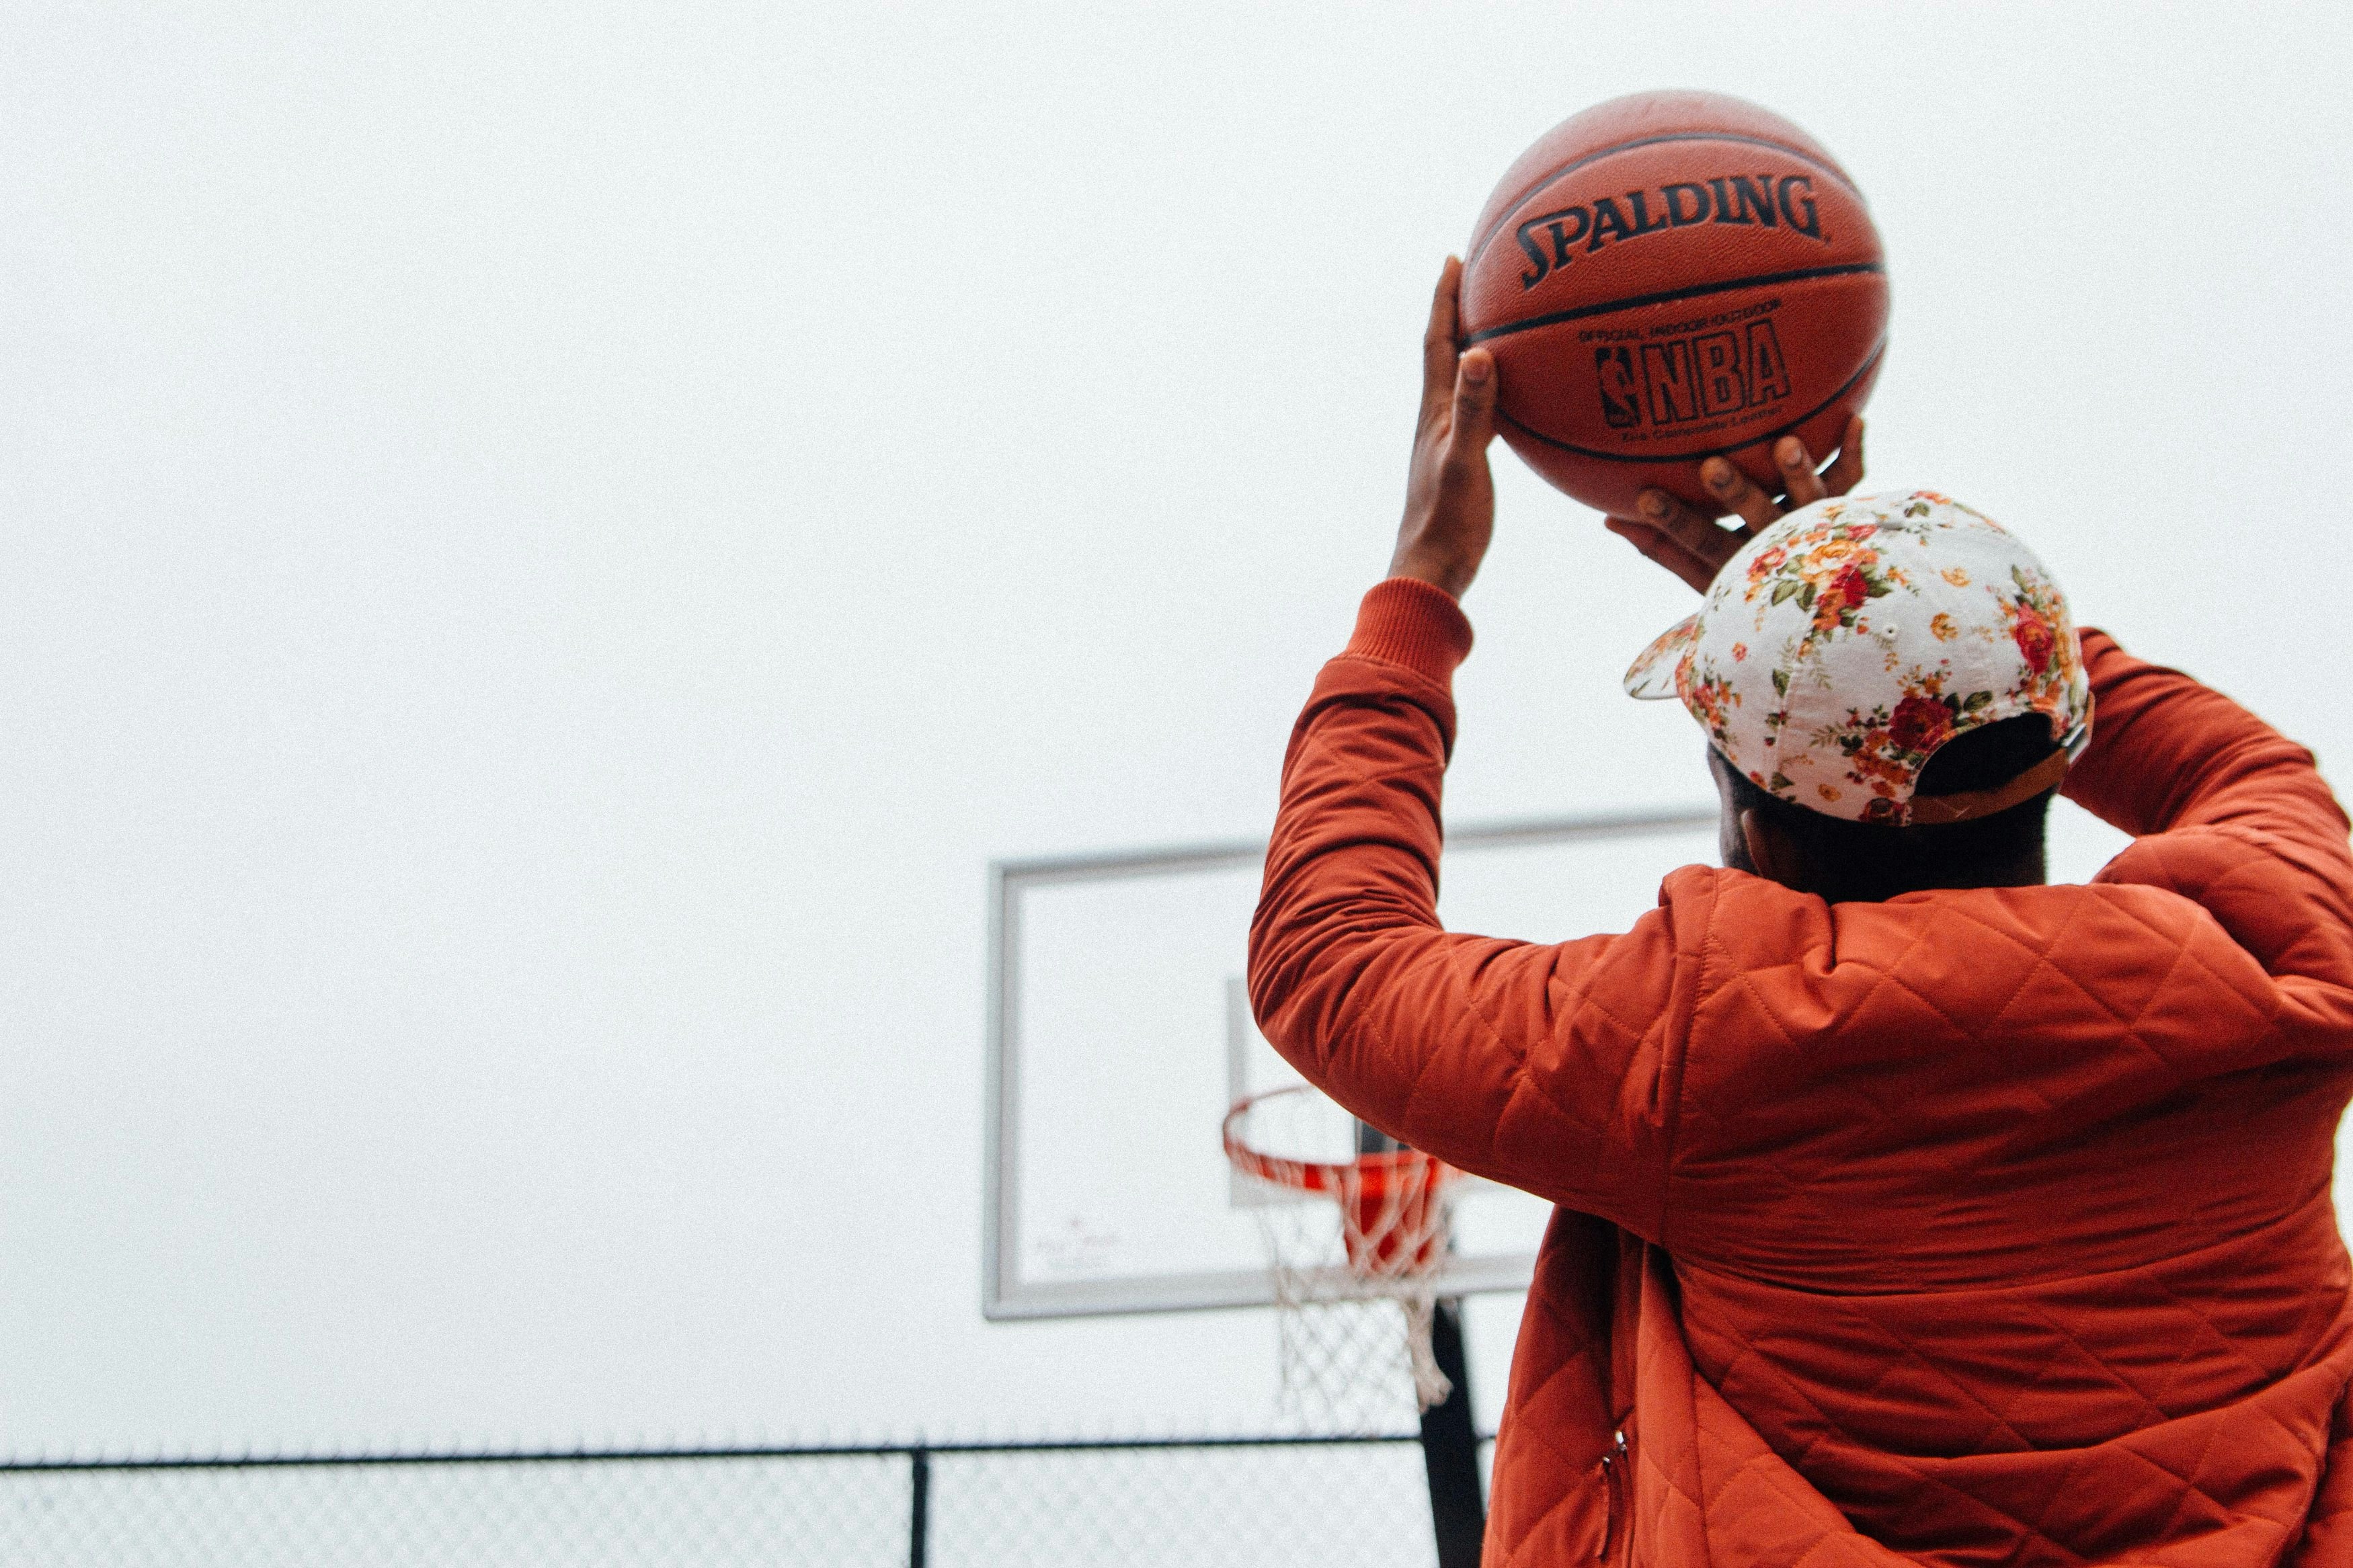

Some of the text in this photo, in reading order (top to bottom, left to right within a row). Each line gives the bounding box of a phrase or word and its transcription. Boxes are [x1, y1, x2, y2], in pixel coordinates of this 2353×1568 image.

[1517, 175, 1821, 291] SPALDING
[1578, 327, 1642, 342] OFFICIAL
[1640, 317, 1792, 426] NBA
